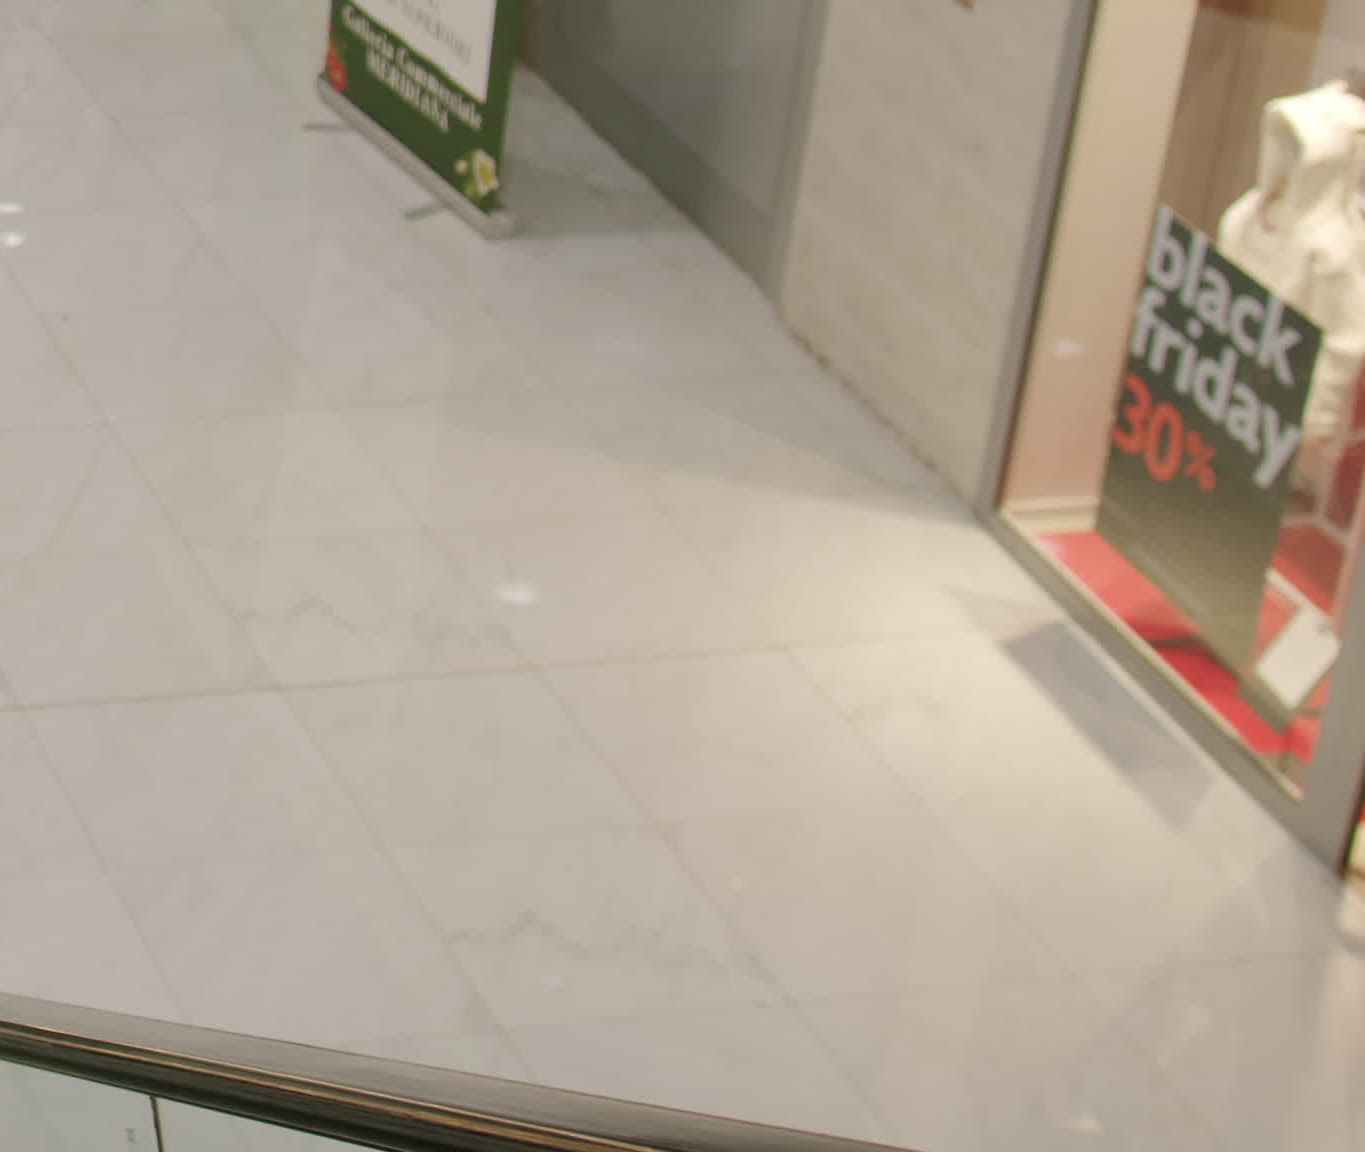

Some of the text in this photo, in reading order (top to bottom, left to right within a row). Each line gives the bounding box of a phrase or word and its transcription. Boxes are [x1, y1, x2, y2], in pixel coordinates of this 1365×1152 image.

[342, 3, 484, 133] Galleria Commerciale
[367, 45, 450, 135] MERIDIANA
[1146, 203, 1303, 389] black
[1111, 371, 1218, 492] 30%
[1130, 285, 1303, 489] friday
